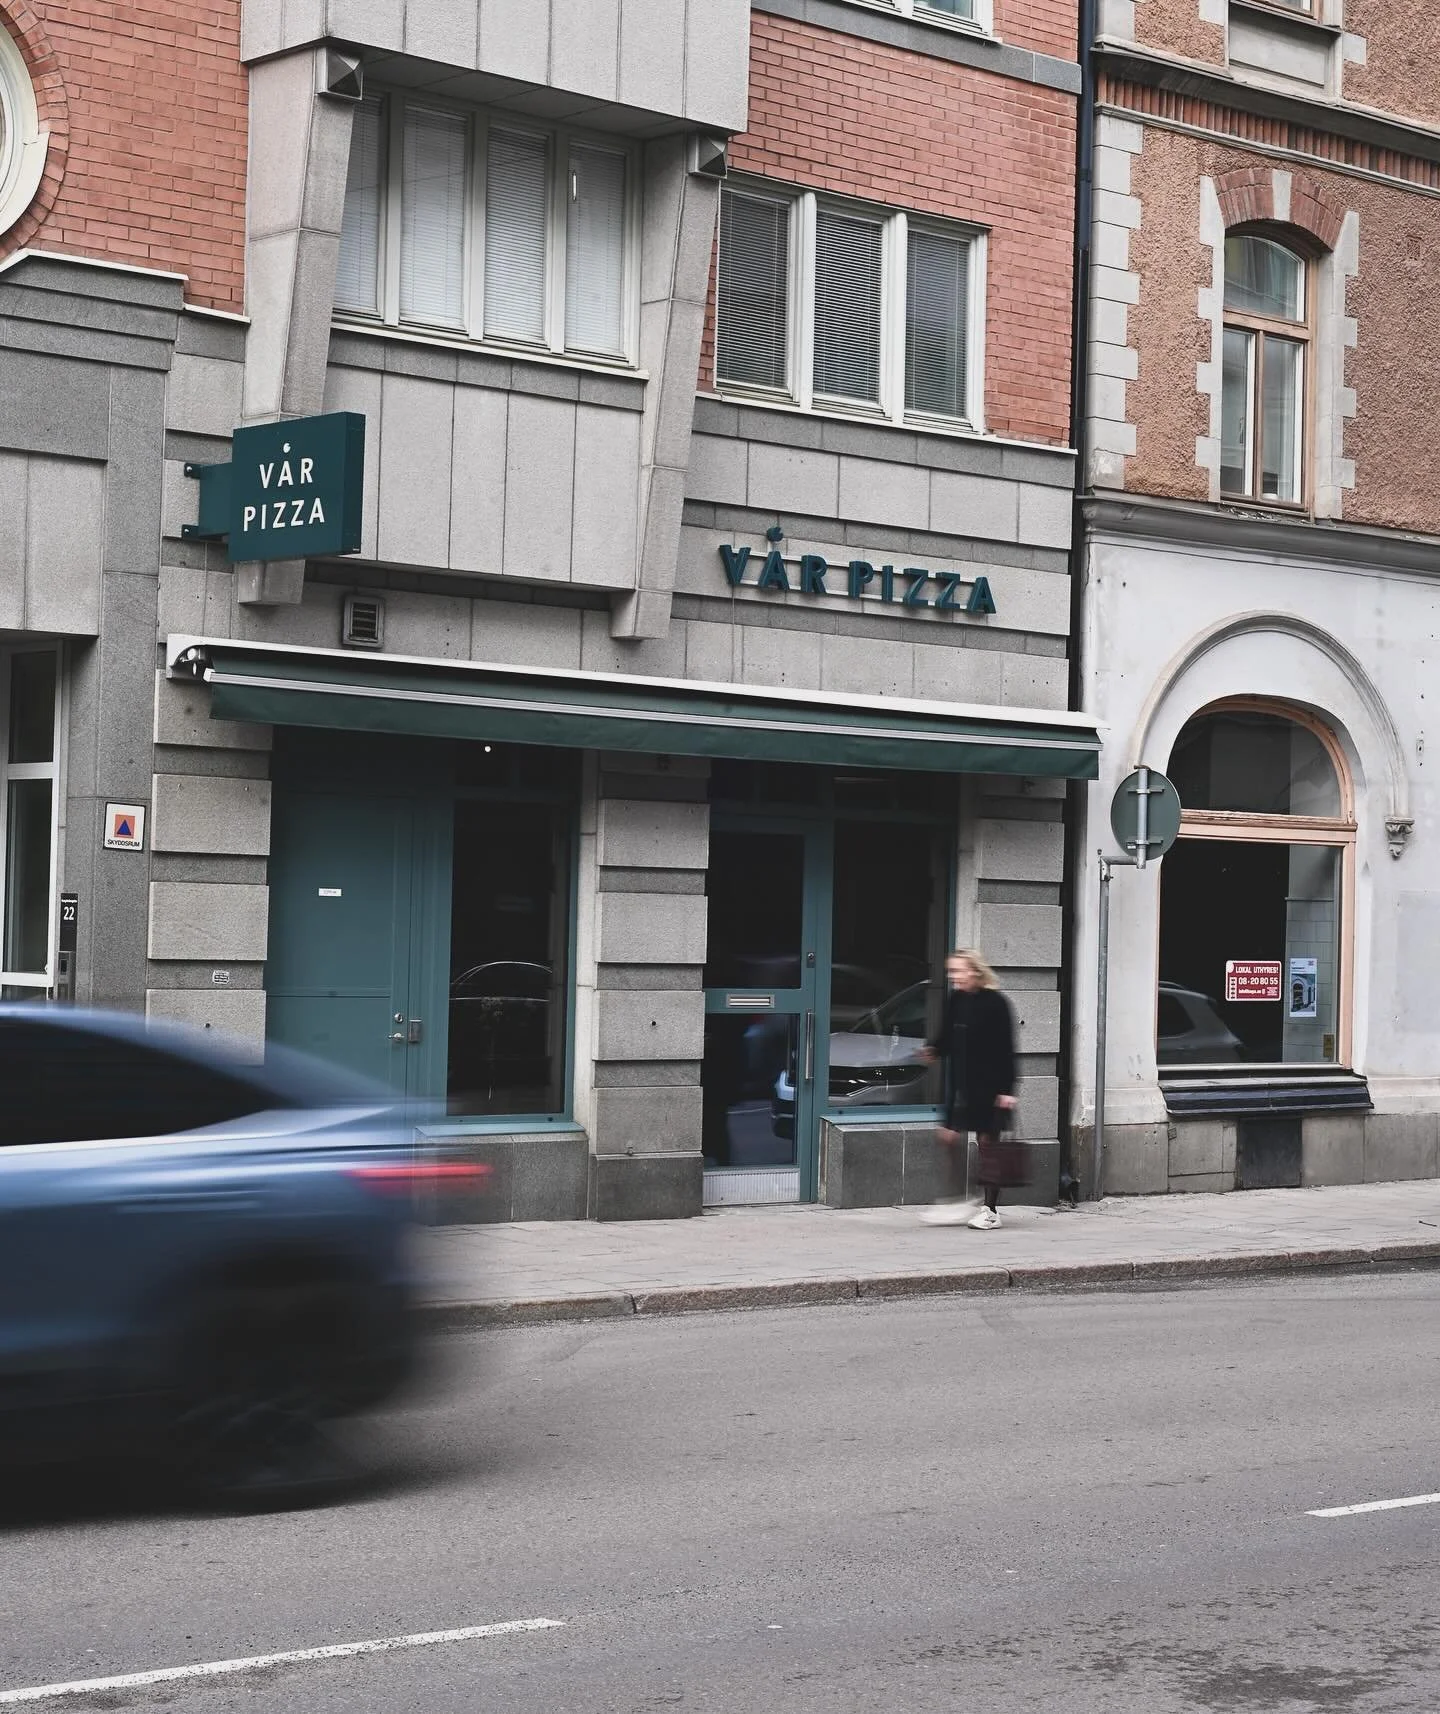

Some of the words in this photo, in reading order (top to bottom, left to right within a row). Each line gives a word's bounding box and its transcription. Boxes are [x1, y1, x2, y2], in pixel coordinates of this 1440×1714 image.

[259, 443, 314, 489] VÅR
[243, 497, 326, 532] PIZZA
[719, 526, 828, 594] VÅR
[848, 560, 997, 615] PIZZA
[63, 906, 75, 921] 22
[1235, 966, 1252, 974] LOKAL
[1253, 966, 1279, 974] UTHYRES!
[1269, 977, 1279, 985] 55
